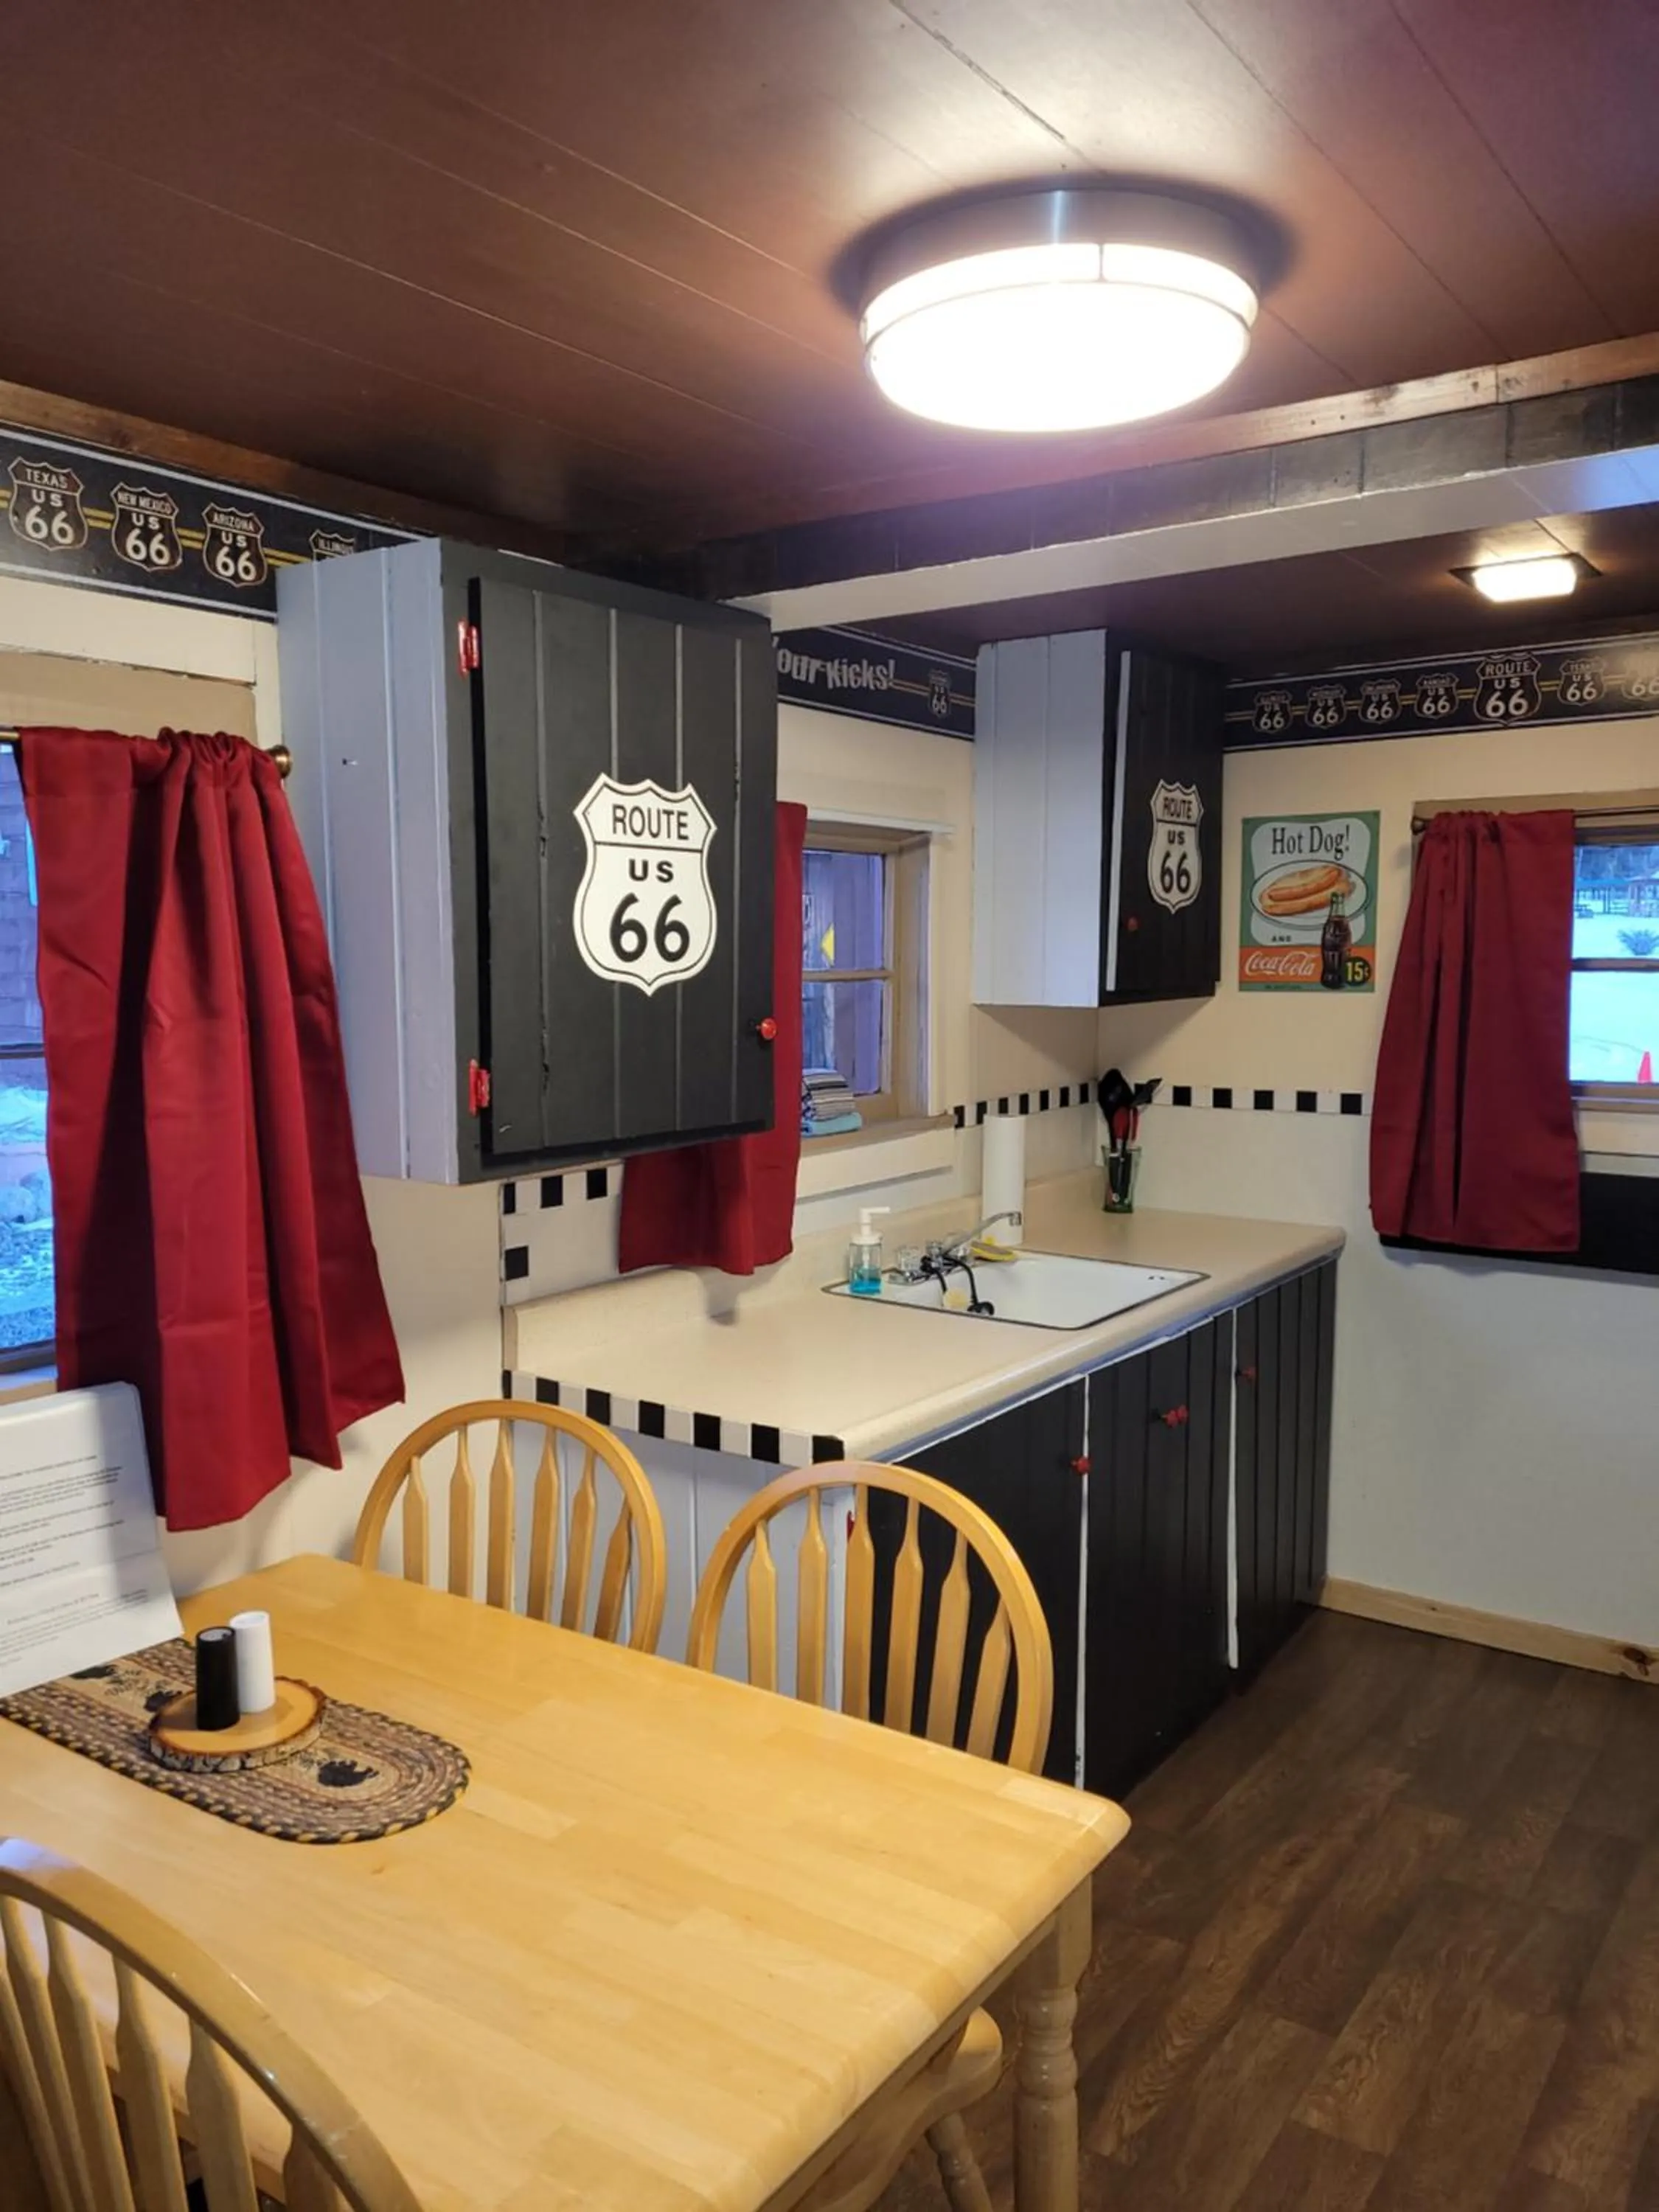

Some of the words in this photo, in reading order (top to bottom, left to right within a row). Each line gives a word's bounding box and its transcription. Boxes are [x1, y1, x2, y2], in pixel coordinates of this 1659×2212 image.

[26, 468, 68, 488] TEXAS
[32, 488, 63, 507] US
[117, 490, 137, 507] NEW
[139, 495, 173, 515] MEXICO
[25, 505, 74, 544] 66
[131, 513, 161, 530] US
[212, 512, 255, 532] ARIZONA
[126, 528, 170, 565] 66
[221, 531, 247, 548] US
[215, 546, 257, 581] 66
[772, 635, 820, 684] our
[1485, 661, 1532, 676] ROUTE
[1494, 677, 1521, 689] US
[1567, 681, 1597, 702] 66
[1366, 701, 1393, 720] 66
[1422, 695, 1450, 714] 66
[1486, 689, 1528, 717] 66
[1259, 712, 1284, 729] 66
[1312, 707, 1339, 725] 66
[1163, 796, 1192, 820] ROUTE
[612, 804, 689, 841] ROUTE
[1167, 830, 1186, 845] US
[1272, 827, 1304, 855] Hot
[1309, 824, 1350, 860] Dog!
[629, 858, 674, 883] US
[1160, 850, 1191, 894] 66
[610, 892, 690, 962] 66
